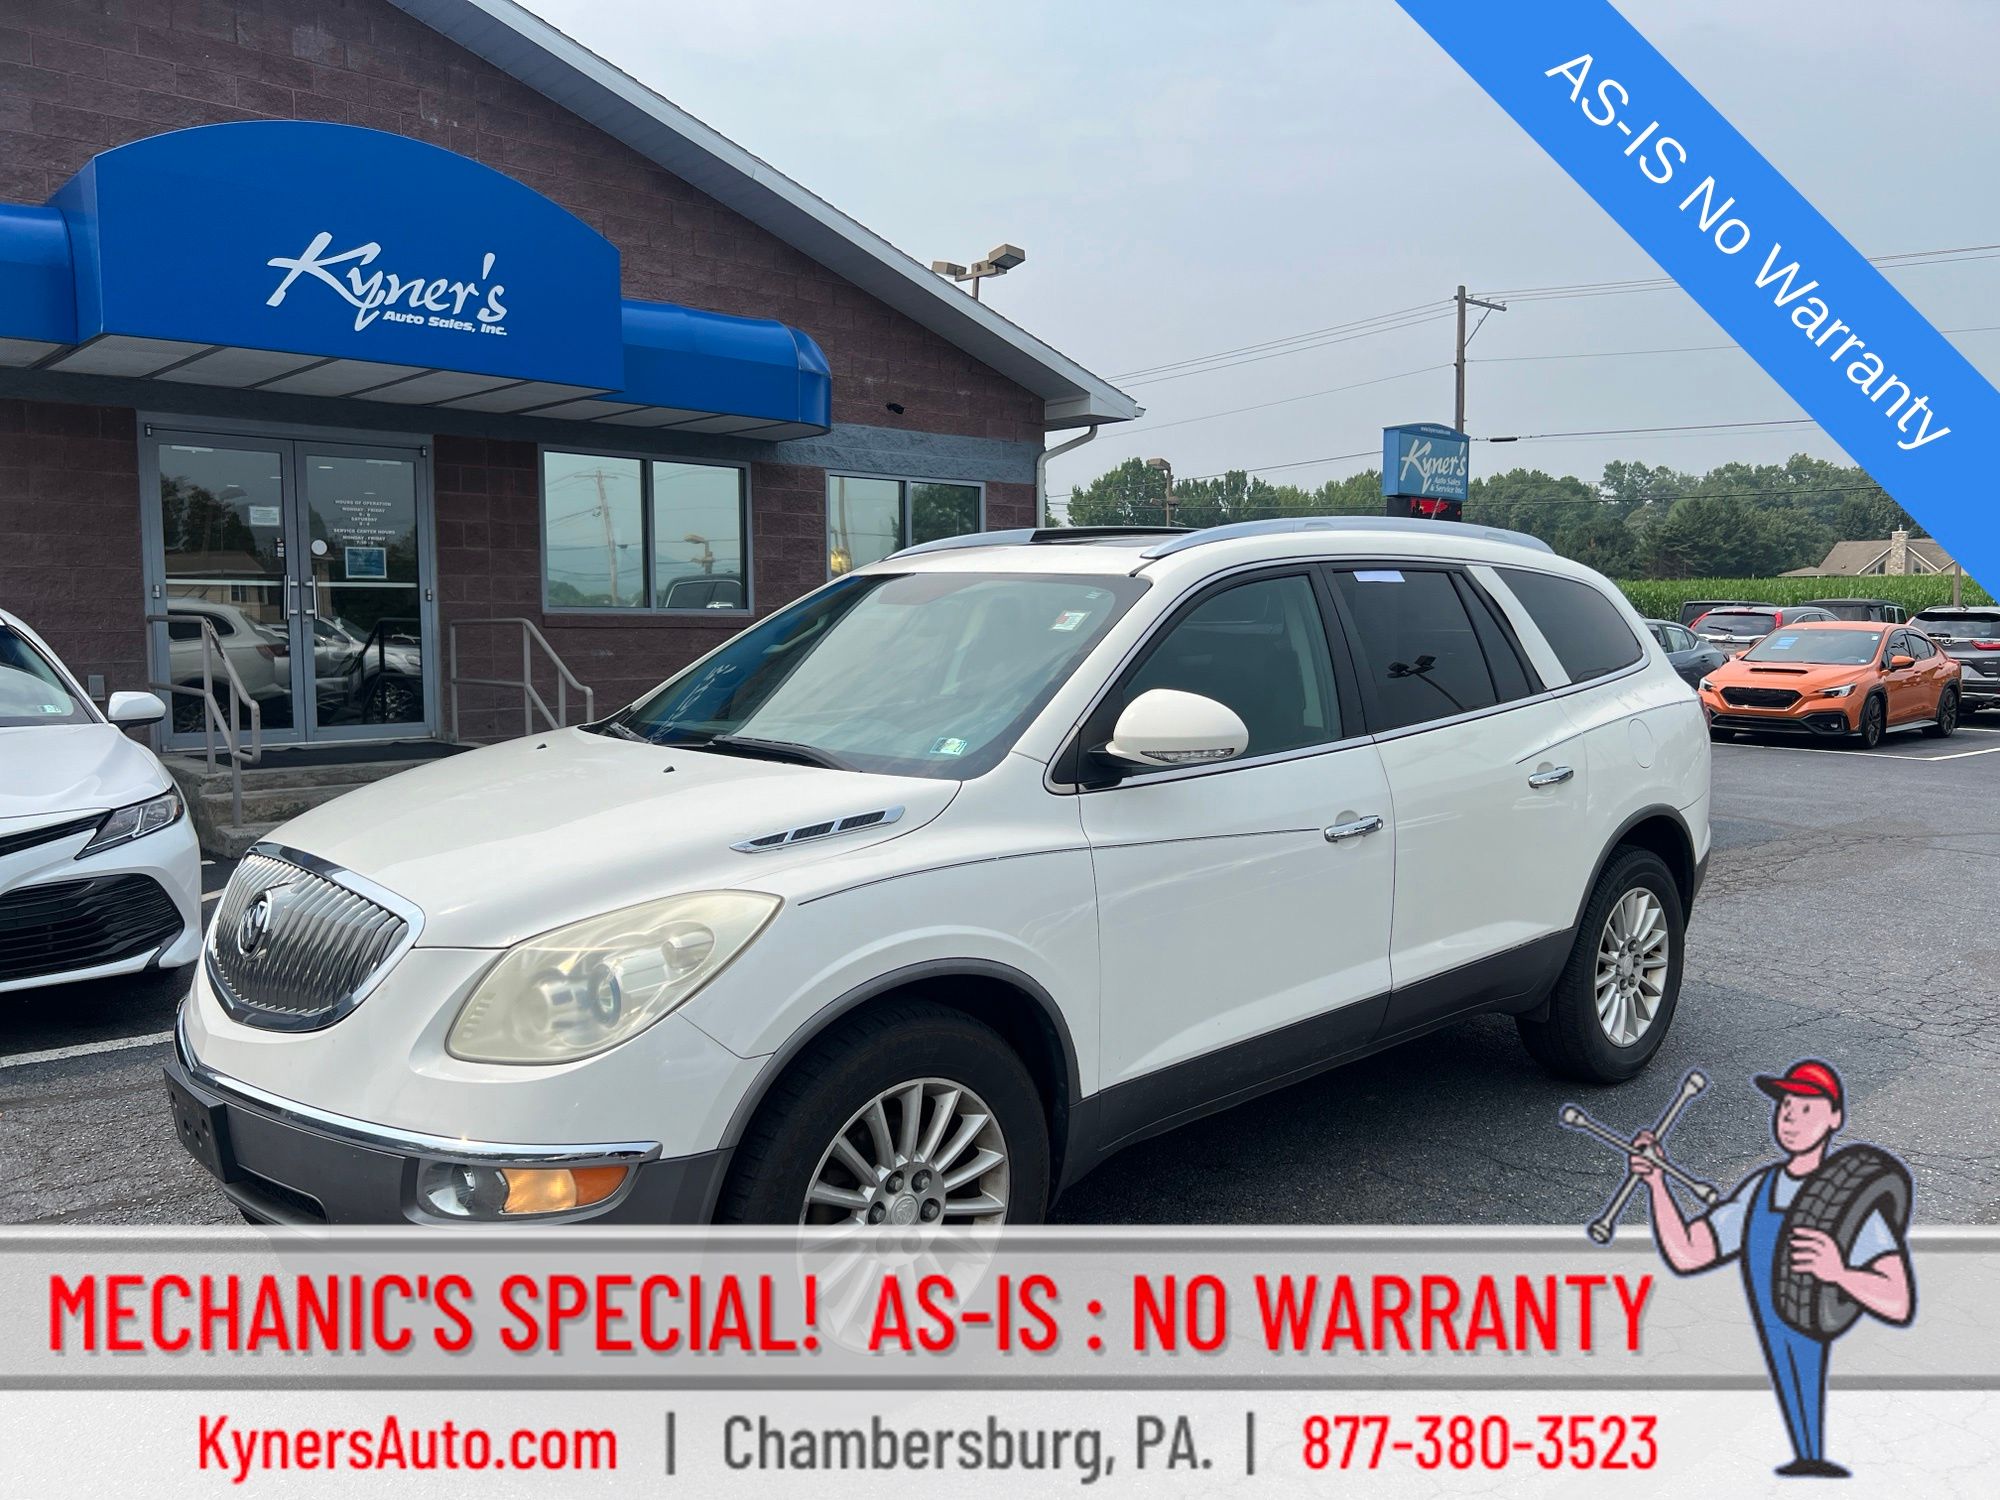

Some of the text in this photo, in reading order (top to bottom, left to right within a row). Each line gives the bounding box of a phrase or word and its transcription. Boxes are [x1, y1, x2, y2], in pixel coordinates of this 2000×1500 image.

[266, 231, 507, 332] Kyner's
[382, 310, 508, 336] Auto Sales, Inc.
[1400, 439, 1466, 494] Kyner's
[1447, 477, 1461, 486] Sales
